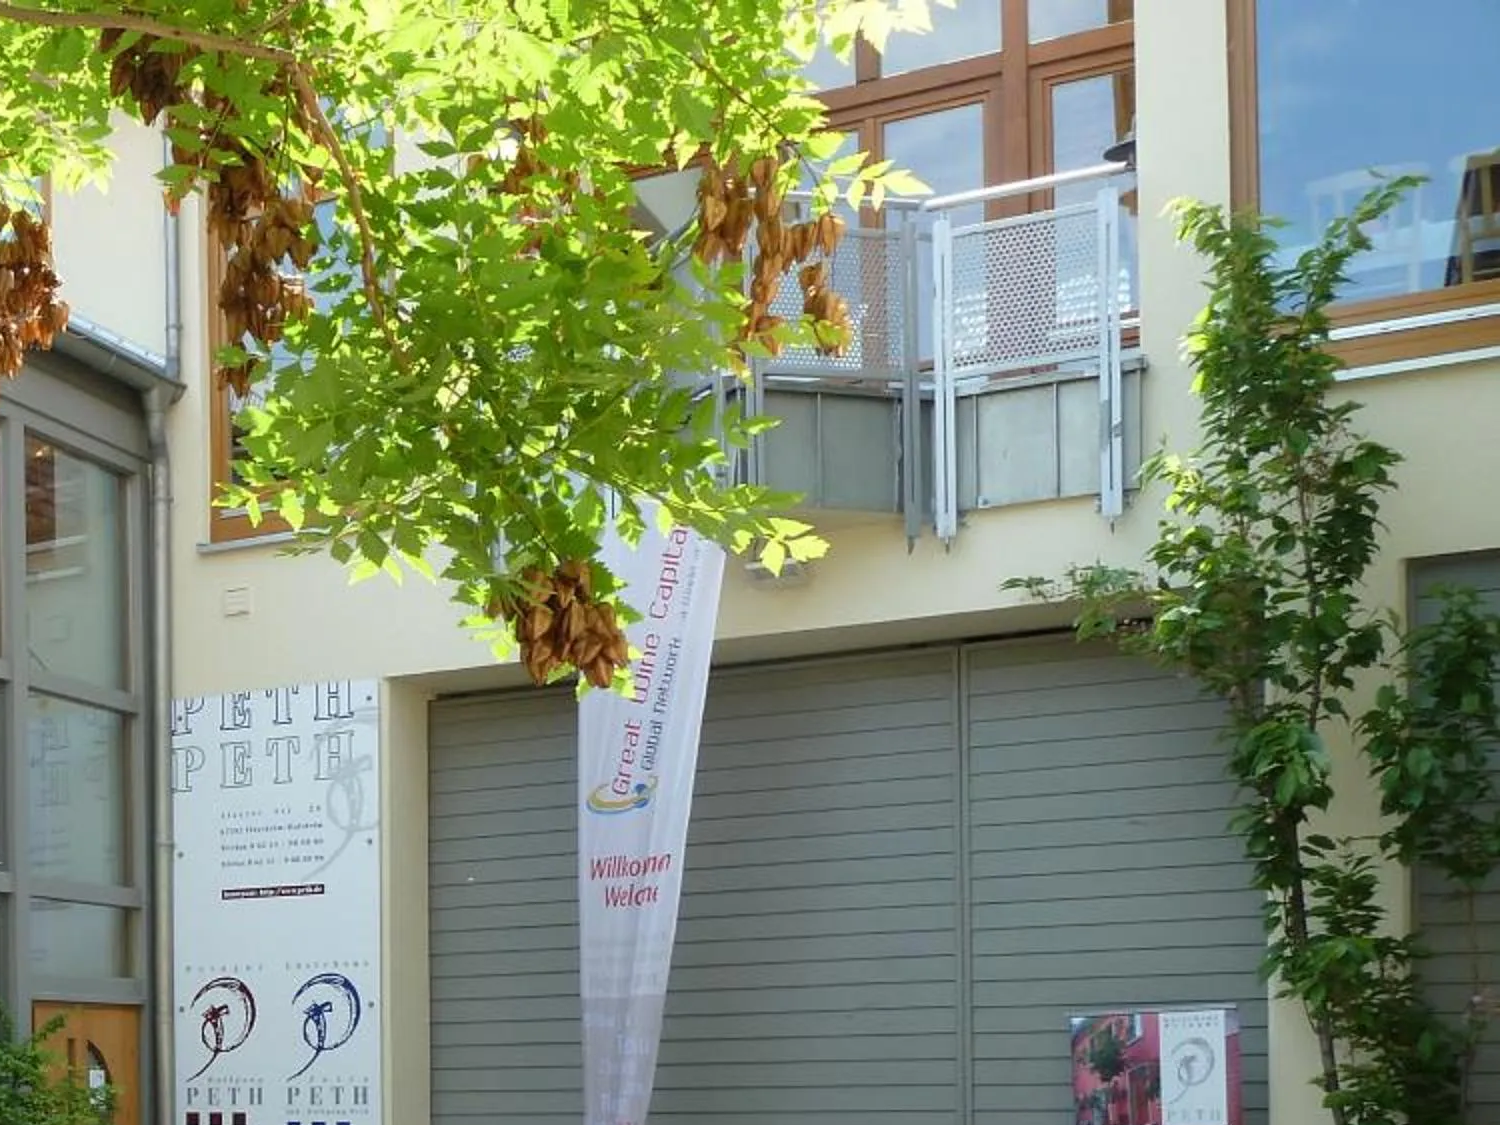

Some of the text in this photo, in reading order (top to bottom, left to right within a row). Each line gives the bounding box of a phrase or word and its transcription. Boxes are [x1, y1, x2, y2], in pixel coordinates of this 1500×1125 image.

[171, 680, 354, 738] PETH
[612, 719, 642, 795] Great
[630, 633, 660, 705] Wine
[171, 730, 354, 793] PETH
[641, 719, 664, 771] Global
[187, 1086, 263, 1106] PETH
[287, 1085, 369, 1106] PETH
